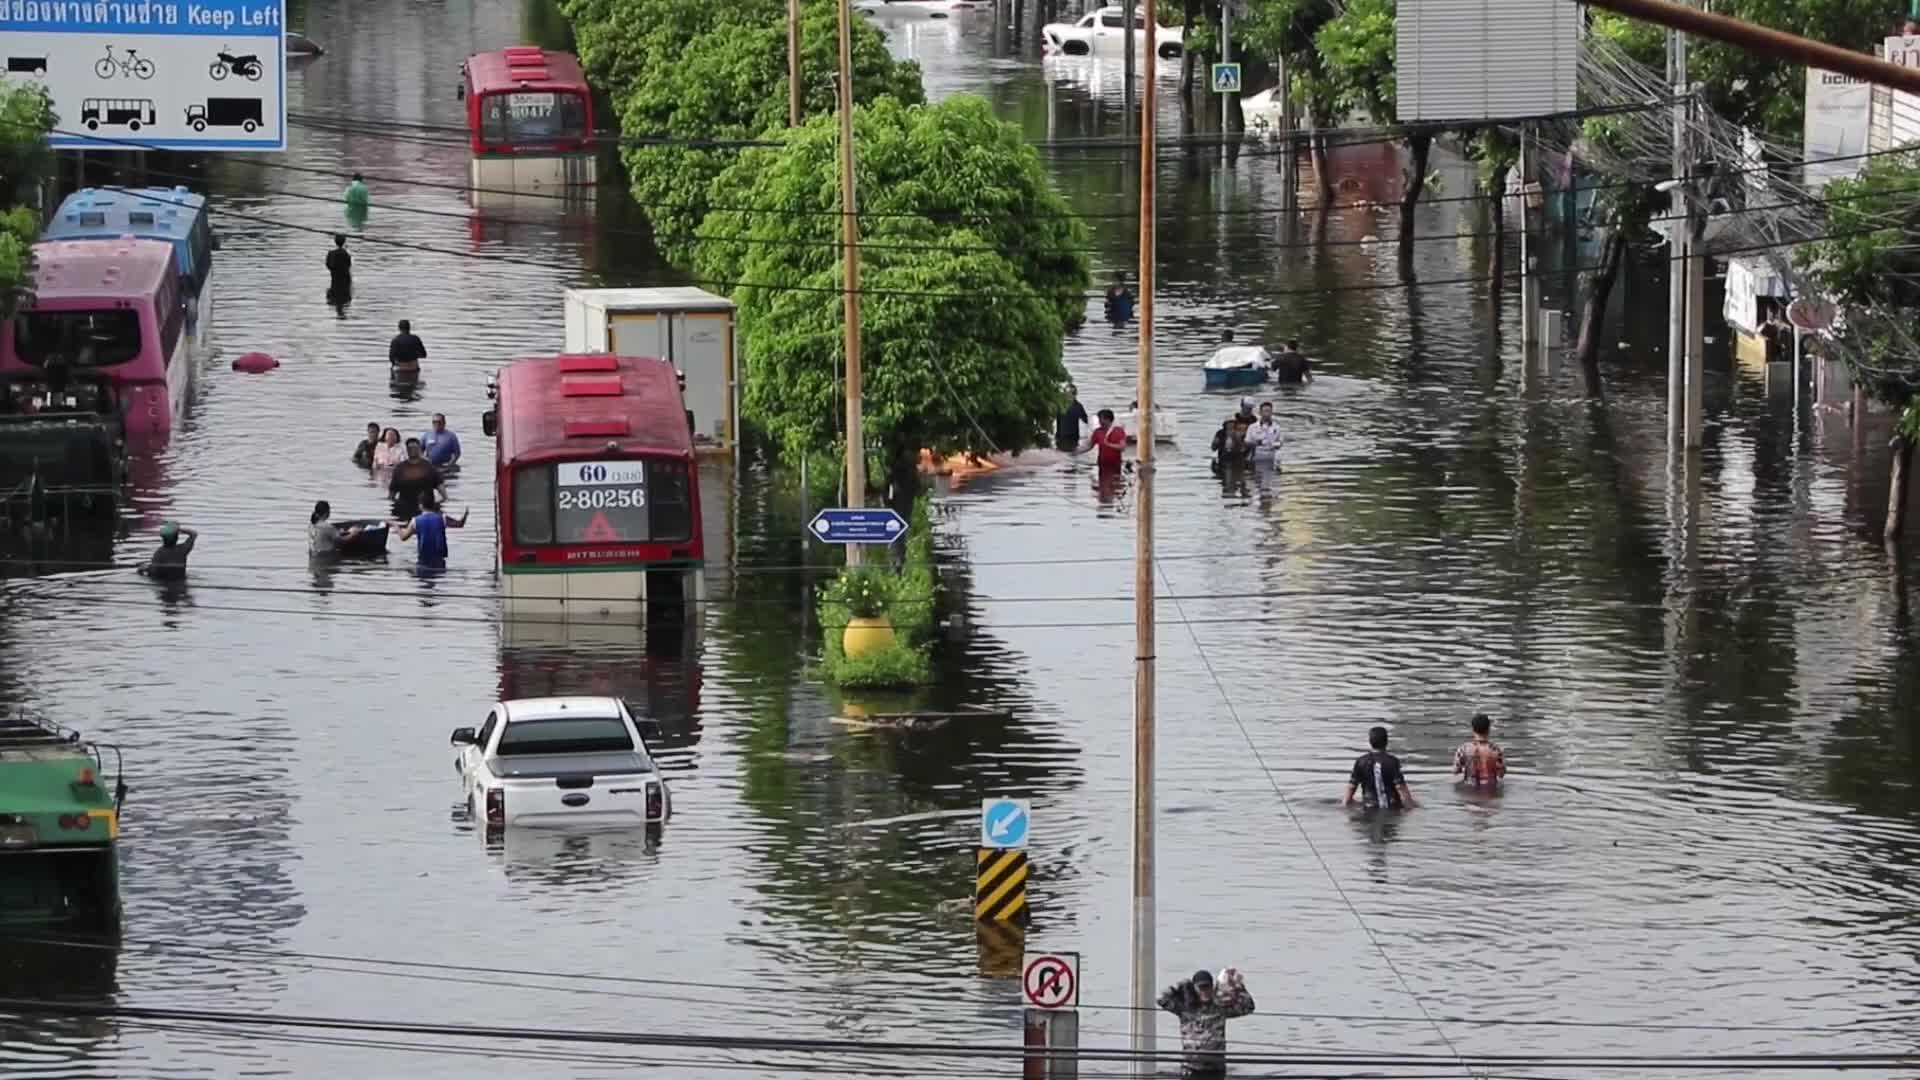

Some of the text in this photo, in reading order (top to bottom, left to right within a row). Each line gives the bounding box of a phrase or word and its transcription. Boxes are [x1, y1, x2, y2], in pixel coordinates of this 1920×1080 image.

[188, 4, 279, 30] Keep Left
[579, 465, 607, 481] 60
